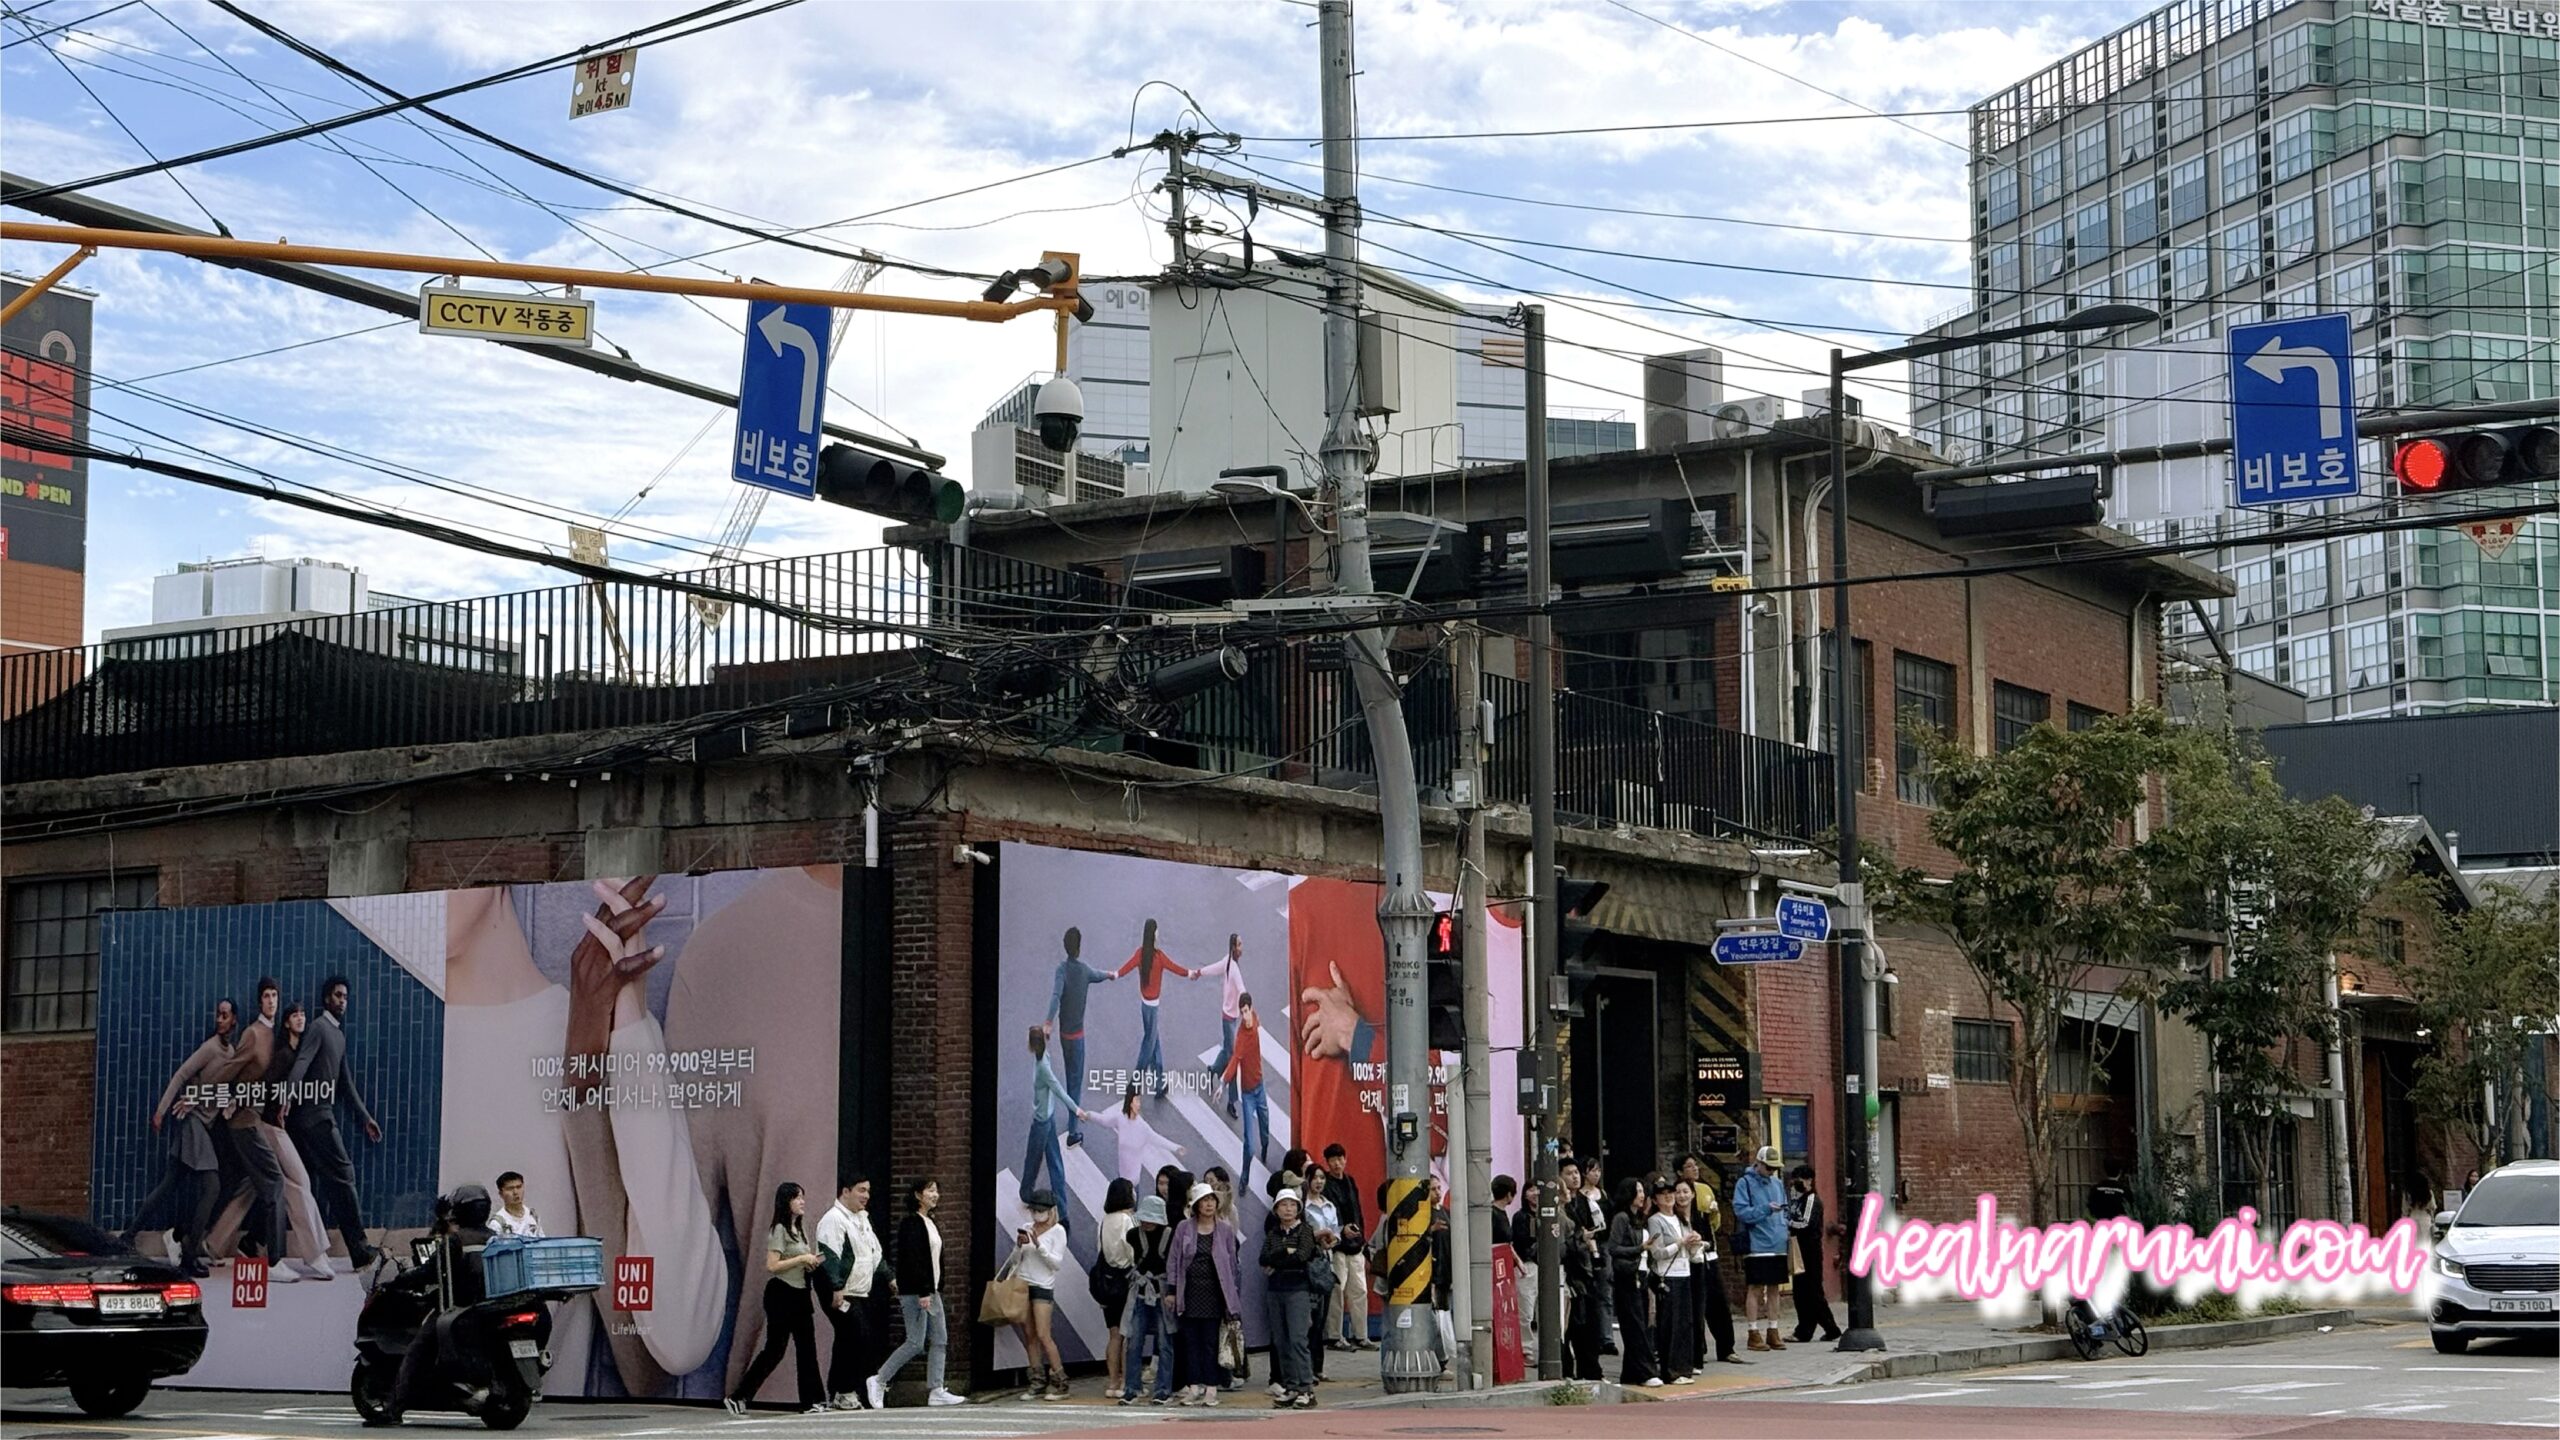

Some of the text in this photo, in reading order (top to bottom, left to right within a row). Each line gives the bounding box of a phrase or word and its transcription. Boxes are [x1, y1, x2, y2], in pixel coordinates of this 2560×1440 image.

[595, 78, 607, 93] kt
[440, 302, 575, 333] CCTV 작동중
[741, 428, 813, 487] 비보호
[2244, 447, 2350, 493] 비보호
[1738, 937, 1780, 951] 연무장길
[531, 1047, 755, 1080] 100% 캐시미어 99,900원부터
[1353, 1062, 1375, 1081] 100%
[1088, 1069, 1212, 1096] 모두를 위한 캐시미어
[1698, 1069, 1744, 1080] DINING
[184, 1078, 336, 1108] 모두를 위한 캐시미어
[541, 1080, 743, 1113] 언제, 어디서나, 편안하게
[237, 1263, 262, 1281] UNI
[618, 1263, 647, 1282] UNI
[130, 1297, 156, 1309] 8840
[236, 1284, 263, 1305] QLO
[618, 1285, 649, 1307] QLO
[2520, 1301, 2546, 1311] 5100
[611, 1323, 653, 1336] LifeWear
